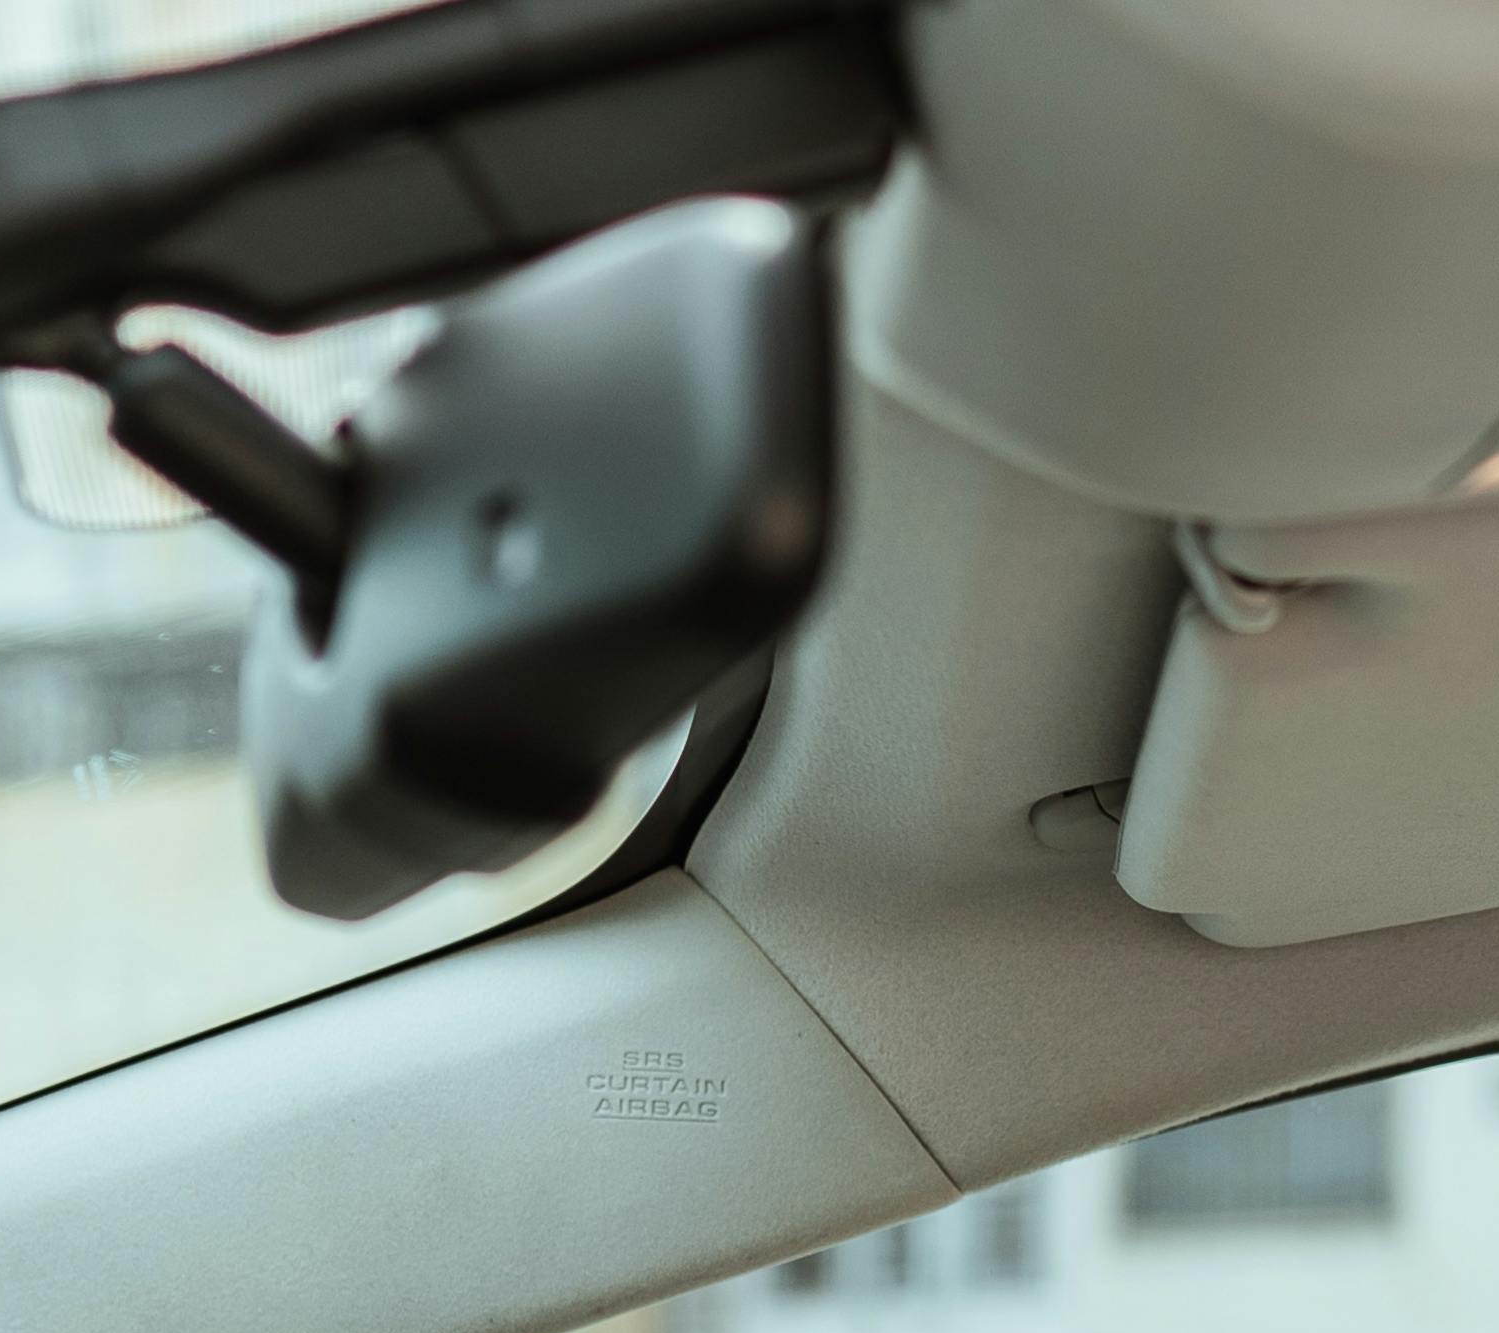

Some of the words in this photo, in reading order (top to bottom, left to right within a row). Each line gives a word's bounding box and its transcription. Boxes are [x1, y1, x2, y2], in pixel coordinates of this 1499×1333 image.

[623, 1050, 684, 1068] SRS
[586, 1073, 727, 1095] CURTAIN
[594, 1097, 718, 1118] AIRBAG
